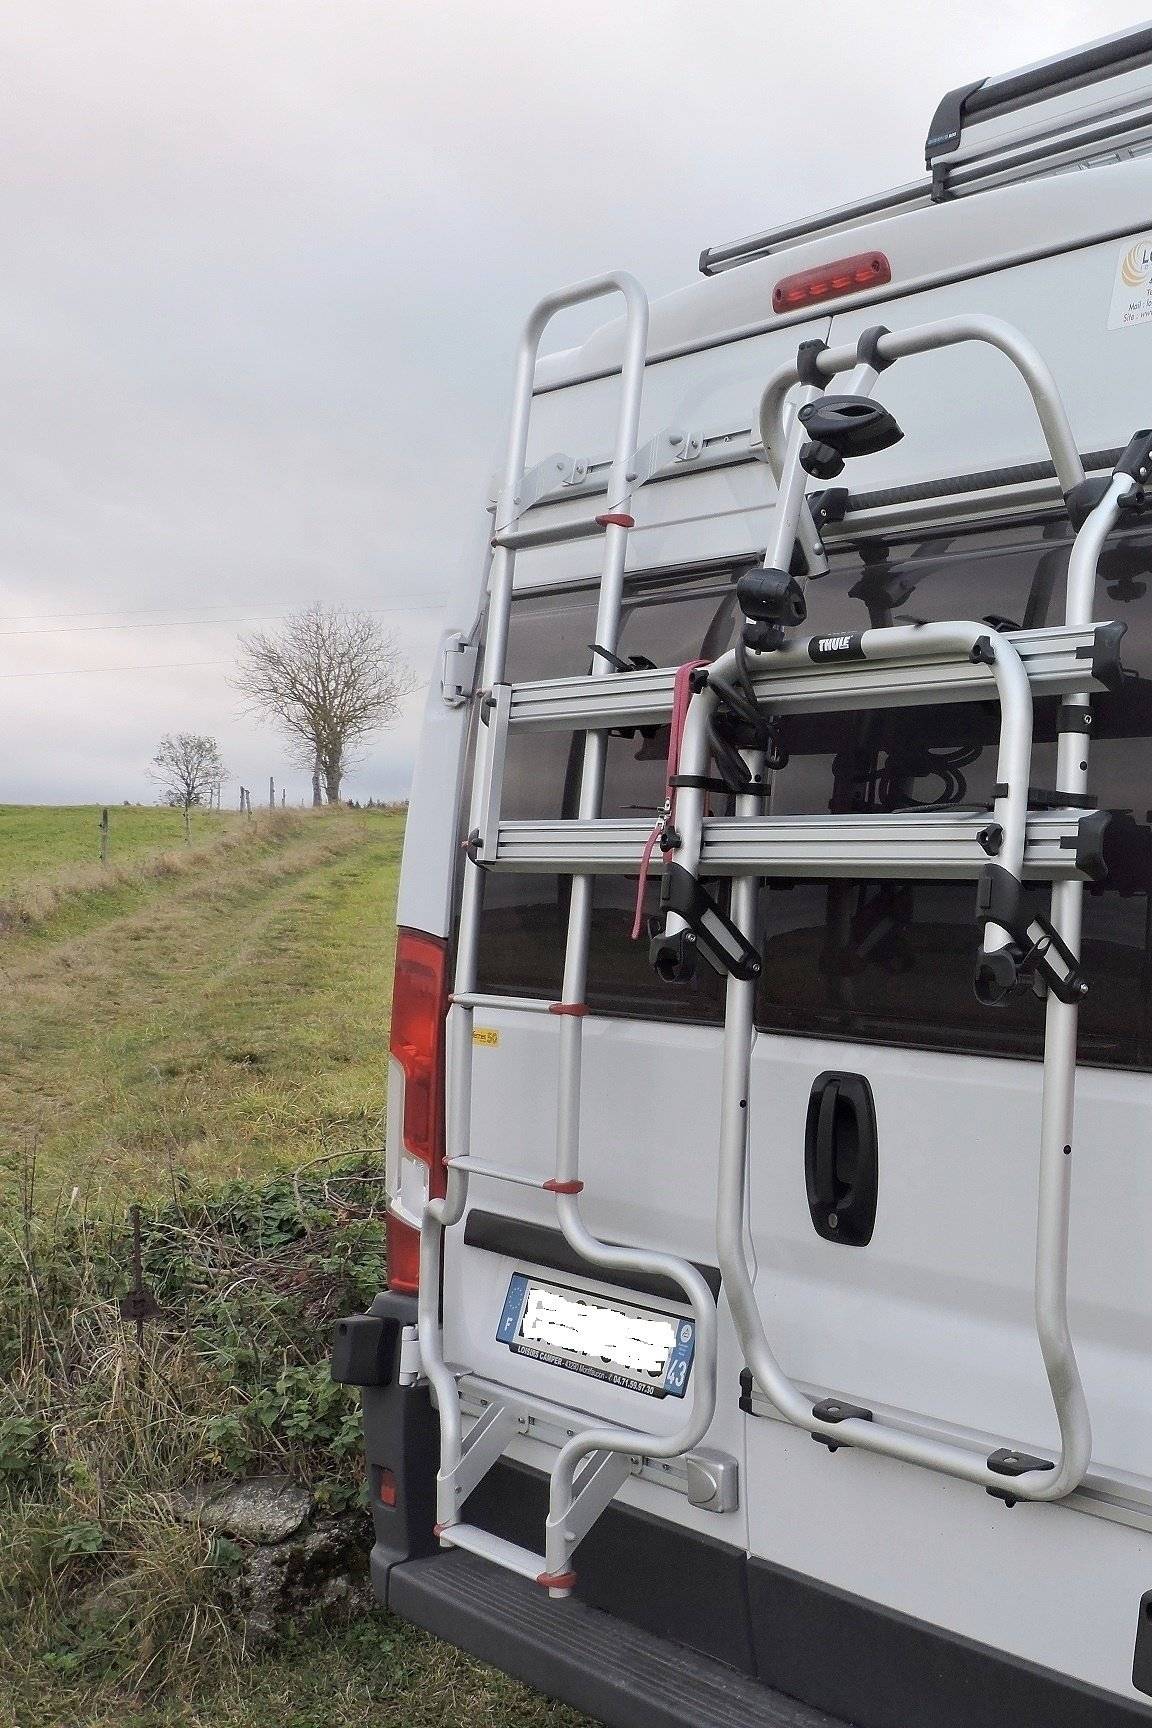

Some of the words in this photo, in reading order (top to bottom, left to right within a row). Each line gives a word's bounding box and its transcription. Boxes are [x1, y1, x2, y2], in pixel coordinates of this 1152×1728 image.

[818, 635, 851, 652] THULE
[504, 1317, 512, 1332] F
[539, 1350, 563, 1366] CAMPER
[667, 1359, 687, 1387] 43
